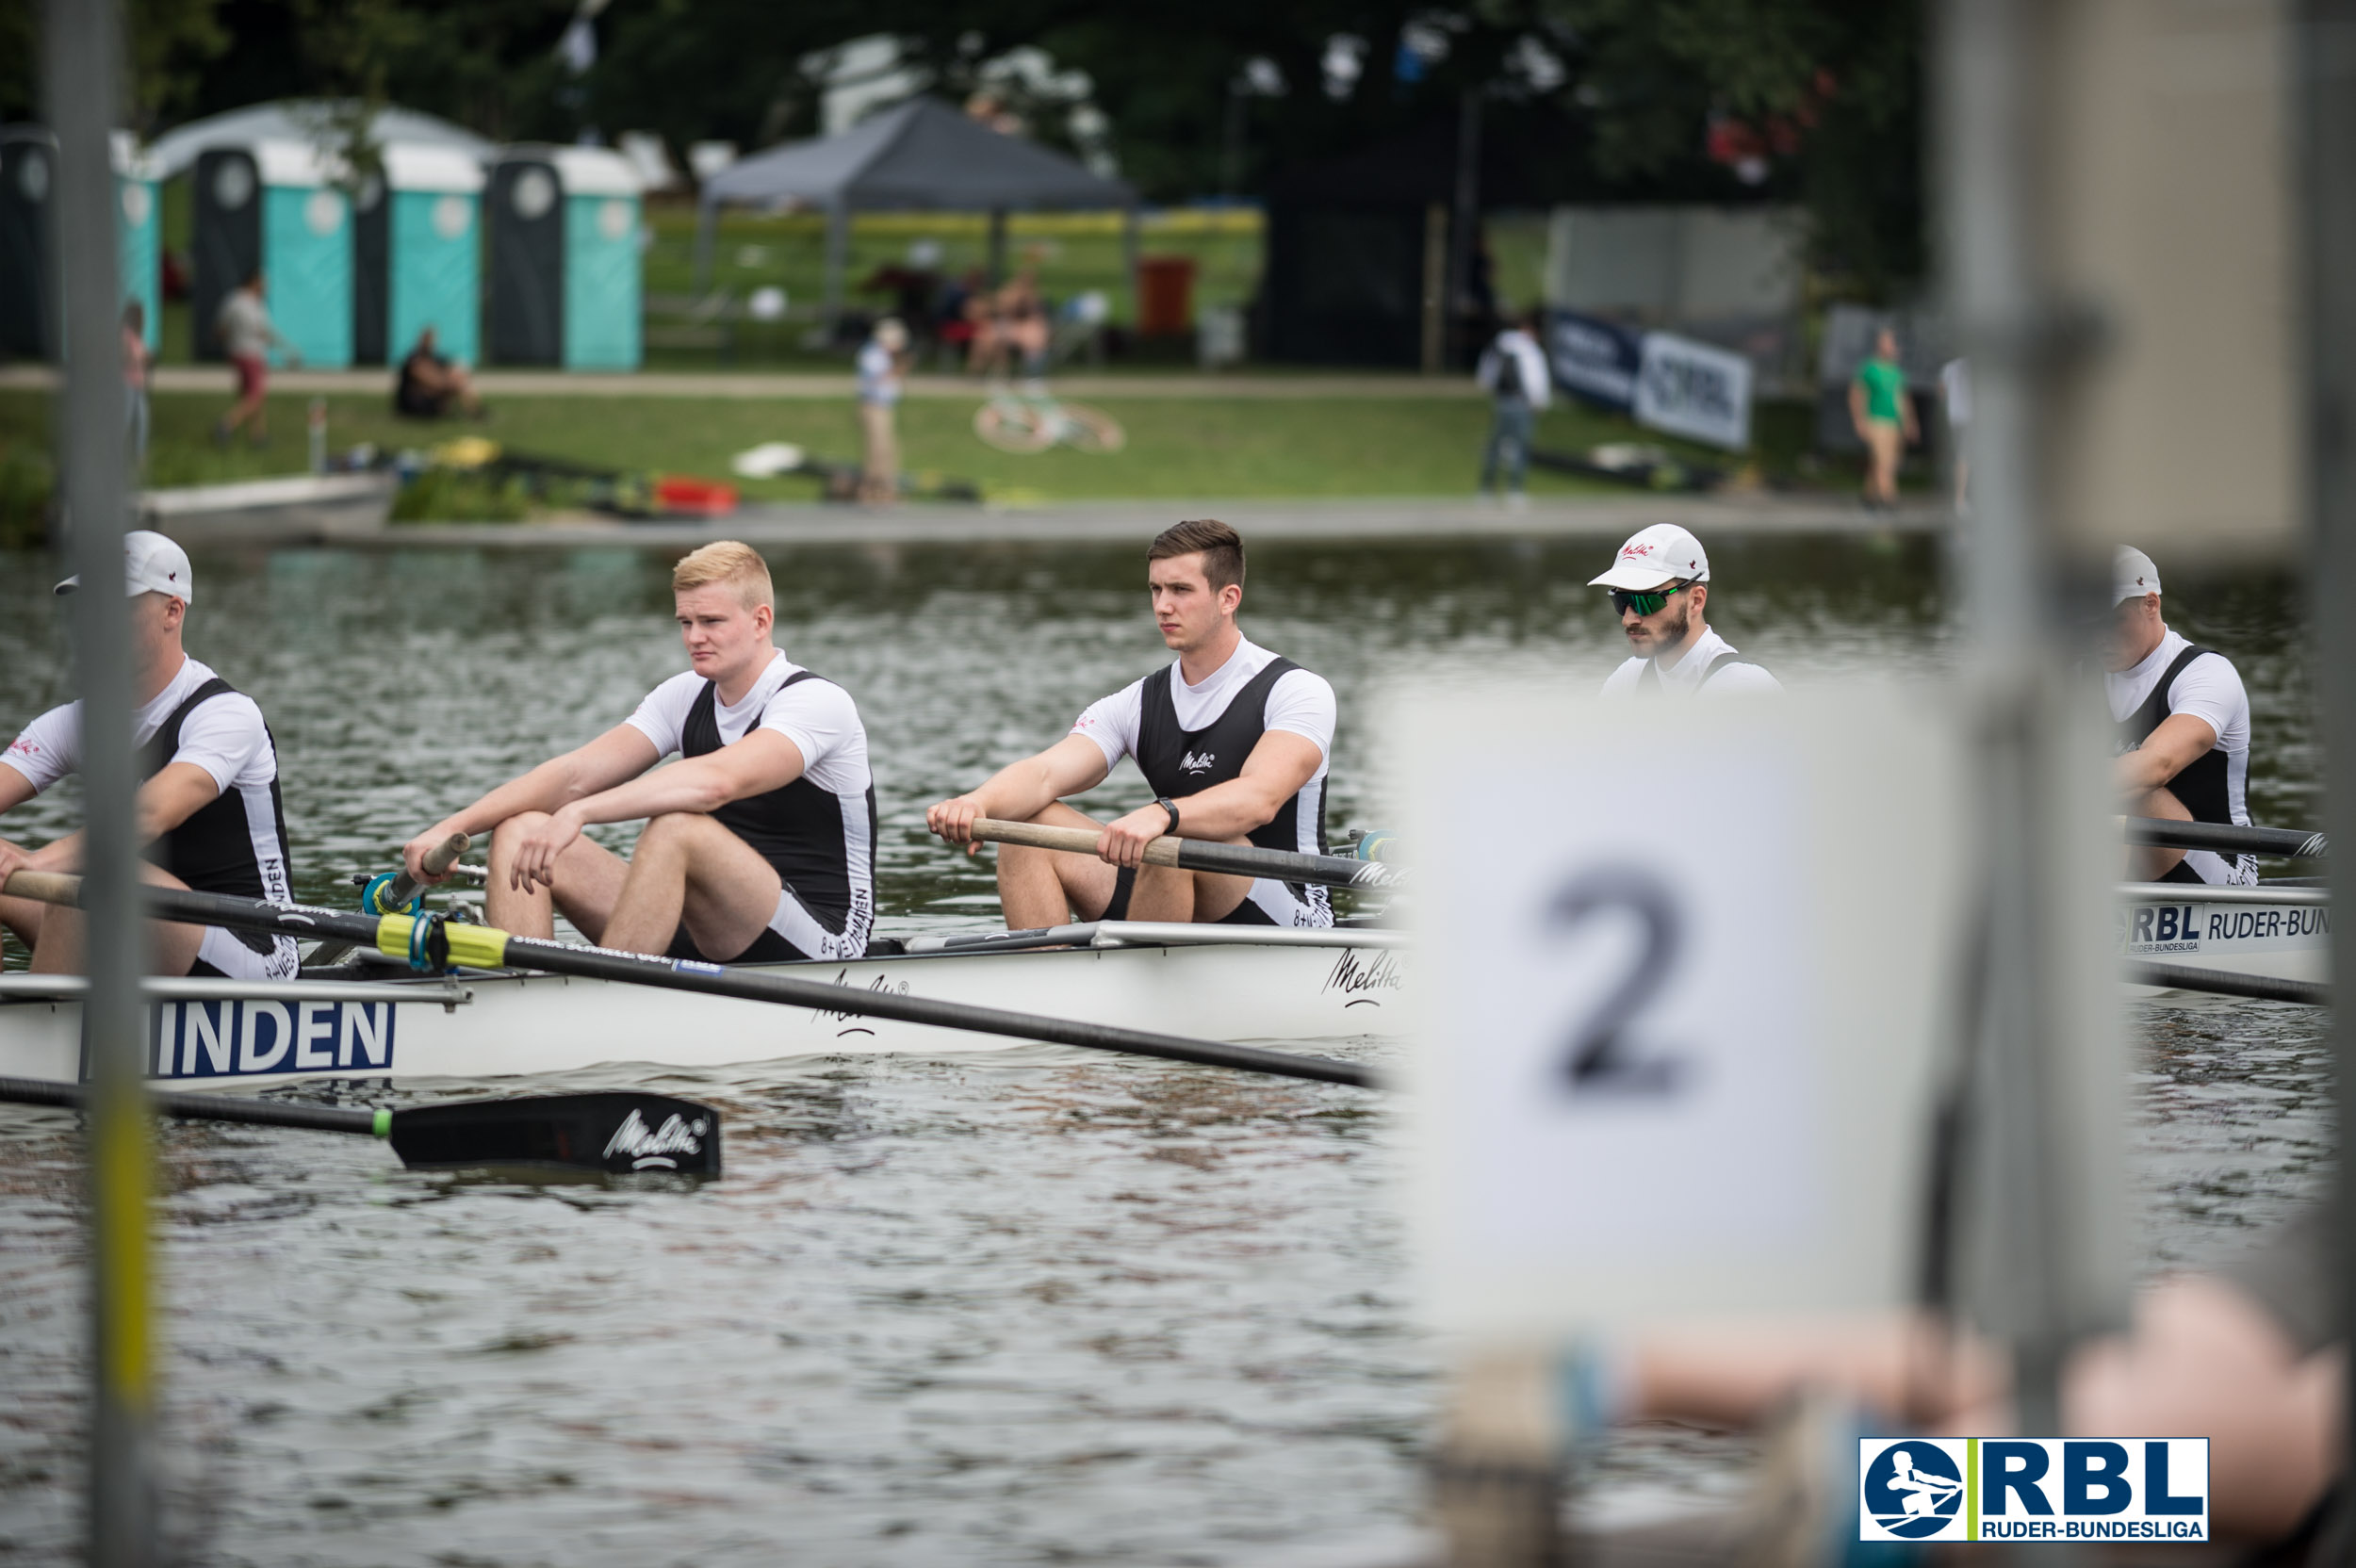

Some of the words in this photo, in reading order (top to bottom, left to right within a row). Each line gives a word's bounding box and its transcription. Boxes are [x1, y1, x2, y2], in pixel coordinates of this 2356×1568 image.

[1179, 750, 1213, 771] Melitta
[2131, 906, 2200, 942] RBL
[2208, 908, 2333, 939] RUDER-BUN
[1320, 947, 1402, 993] Melitta
[1544, 862, 1693, 1098] 2
[143, 999, 388, 1076] INDEN
[602, 1108, 702, 1159] Melitta
